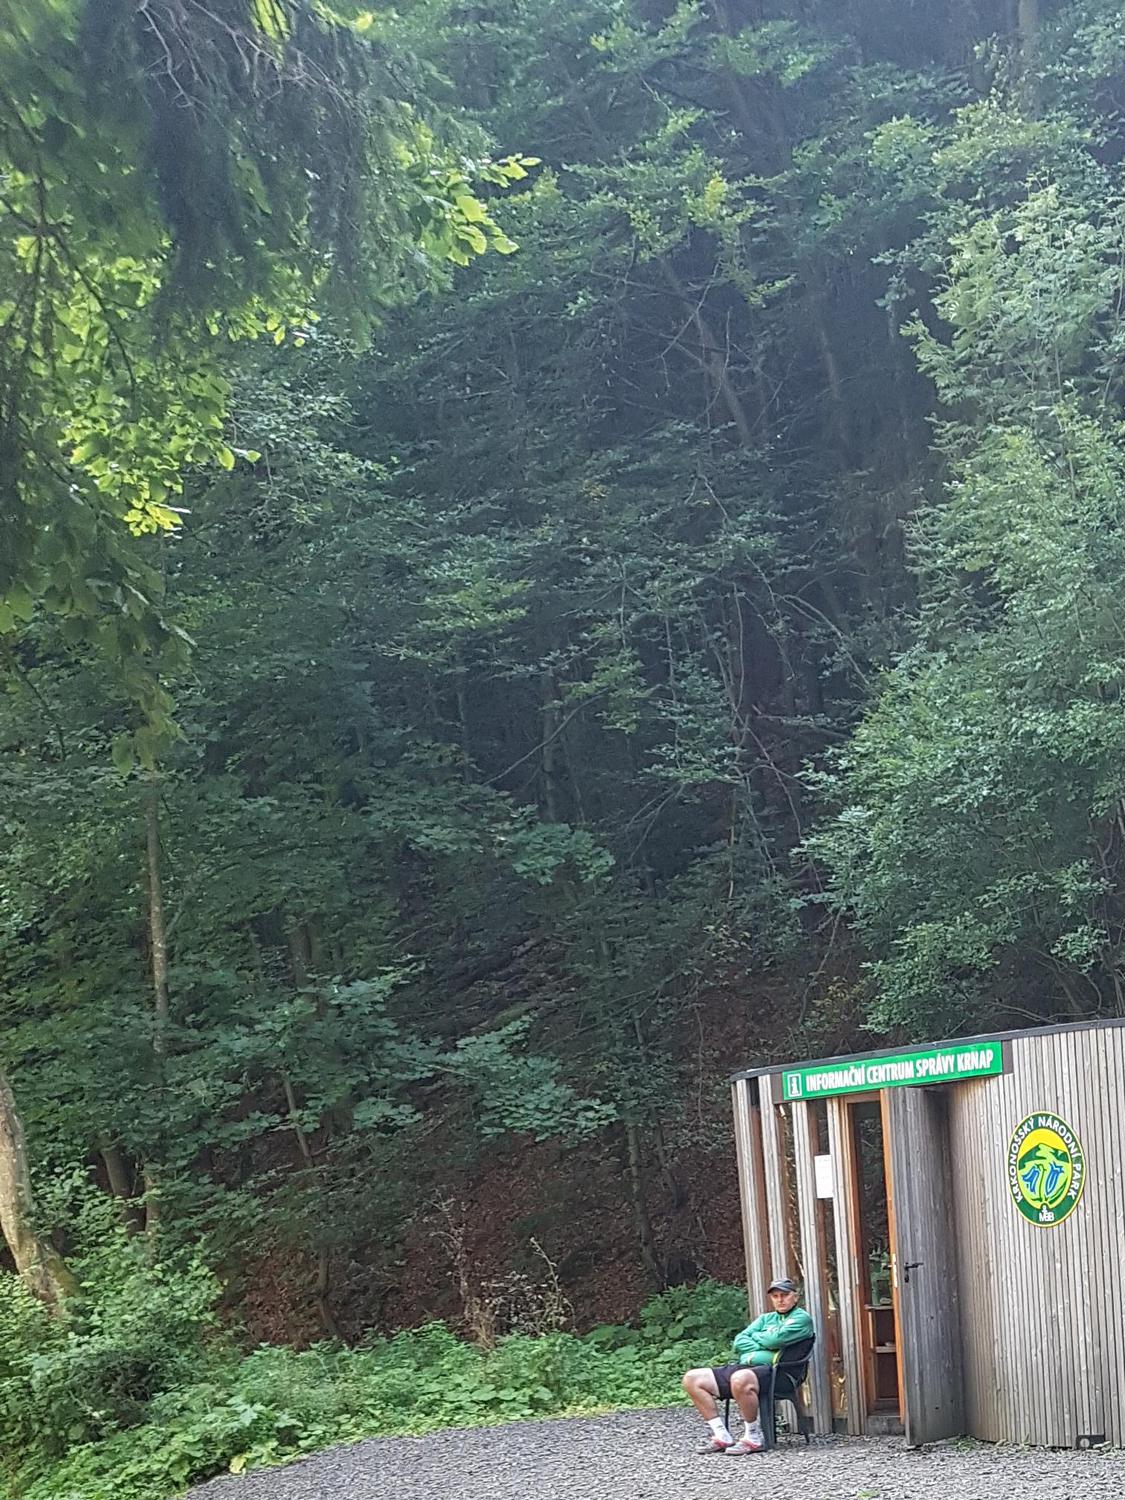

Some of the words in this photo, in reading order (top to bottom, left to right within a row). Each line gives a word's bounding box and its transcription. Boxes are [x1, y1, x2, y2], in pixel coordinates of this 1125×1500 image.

[806, 1064, 866, 1092] INFORMAČNÍ
[867, 1059, 915, 1084] CENTRUM
[916, 1053, 955, 1079] SPRÁVY
[956, 1049, 994, 1073] KRNAP
[1038, 1115, 1082, 1158] NÁRODNÍ
[1067, 1163, 1082, 1200] PARK
